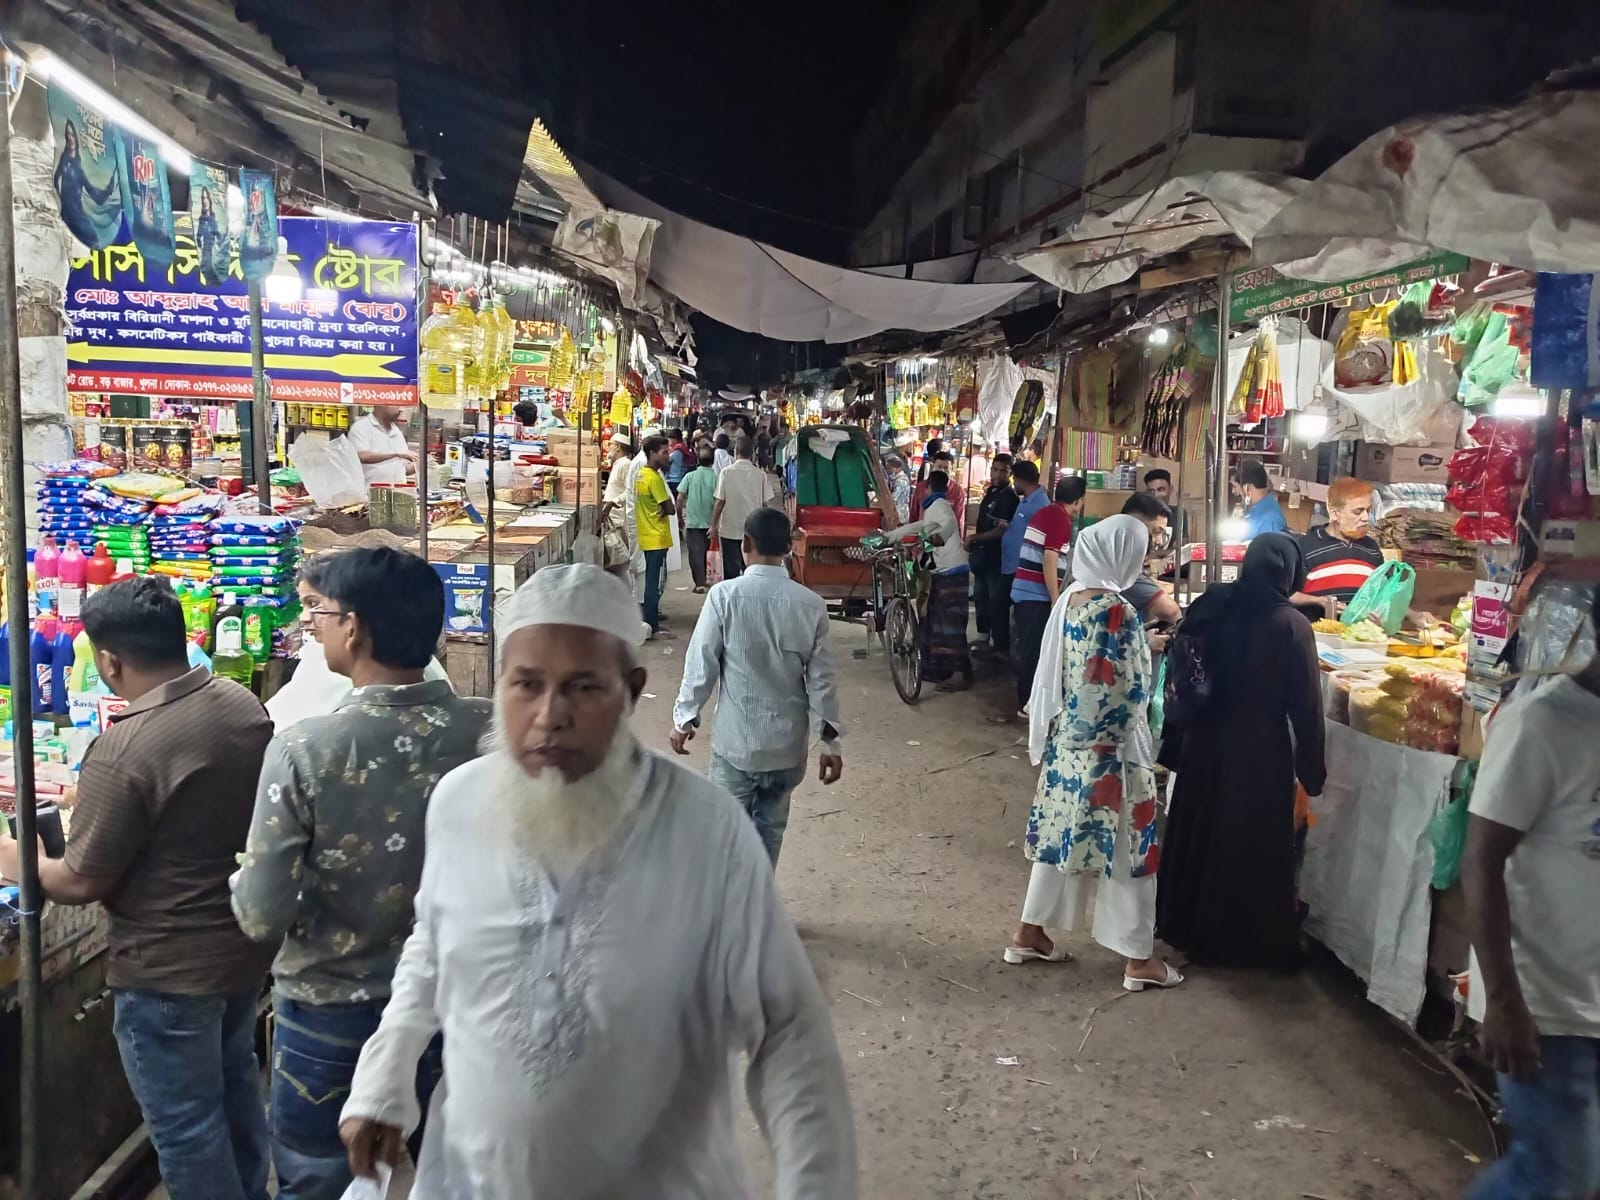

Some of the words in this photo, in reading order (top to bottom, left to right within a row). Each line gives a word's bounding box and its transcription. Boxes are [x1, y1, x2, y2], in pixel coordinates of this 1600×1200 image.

[75, 288, 119, 305] মোঃ
[123, 291, 218, 311] আব্দুল্লাহ
[343, 300, 407, 322] (বাবু)
[67, 308, 120, 323] সর্বপ্রকার
[124, 309, 176, 325] বিরিয়ানী
[217, 317, 229, 326] ও
[261, 318, 314, 332] মনোহারী
[318, 322, 343, 333] দ্রব্য
[192, 330, 244, 344] পাইকারী
[264, 335, 295, 348] খুচরা
[298, 335, 335, 349] বিক্রয়
[339, 339, 364, 351] করা
[367, 340, 387, 351] হয়
